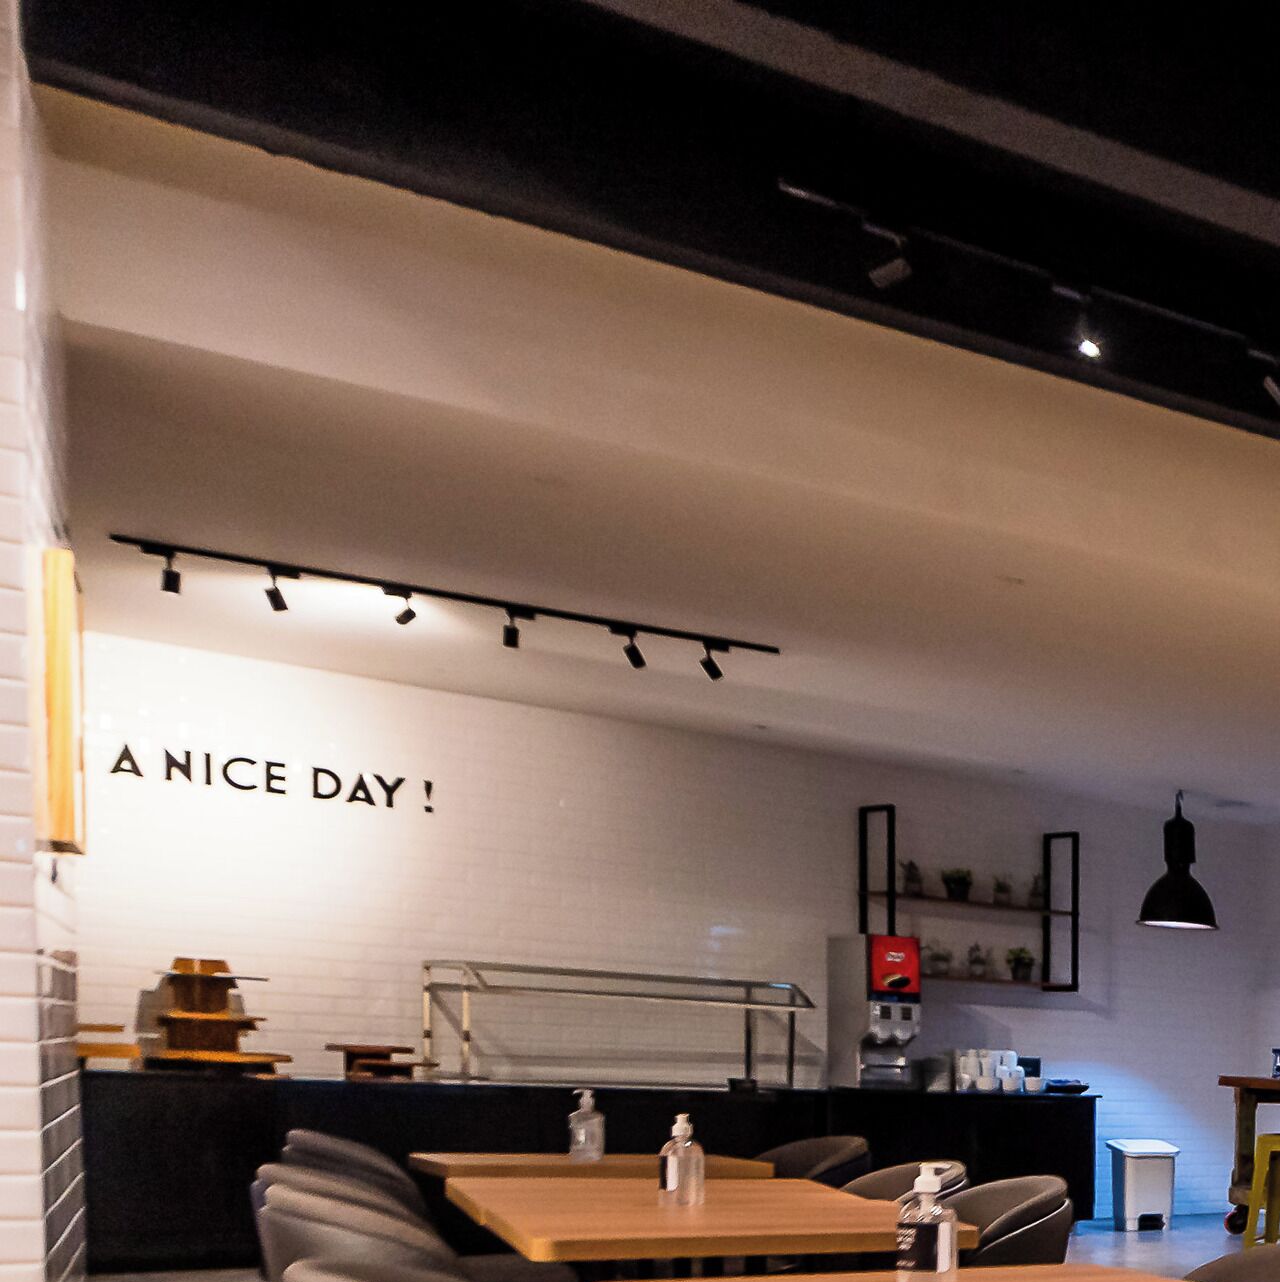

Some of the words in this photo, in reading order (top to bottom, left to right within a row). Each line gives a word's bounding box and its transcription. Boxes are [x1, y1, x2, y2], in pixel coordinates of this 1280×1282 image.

[110, 744, 144, 778] A
[163, 749, 288, 795] NICE
[311, 767, 406, 809] DAY
